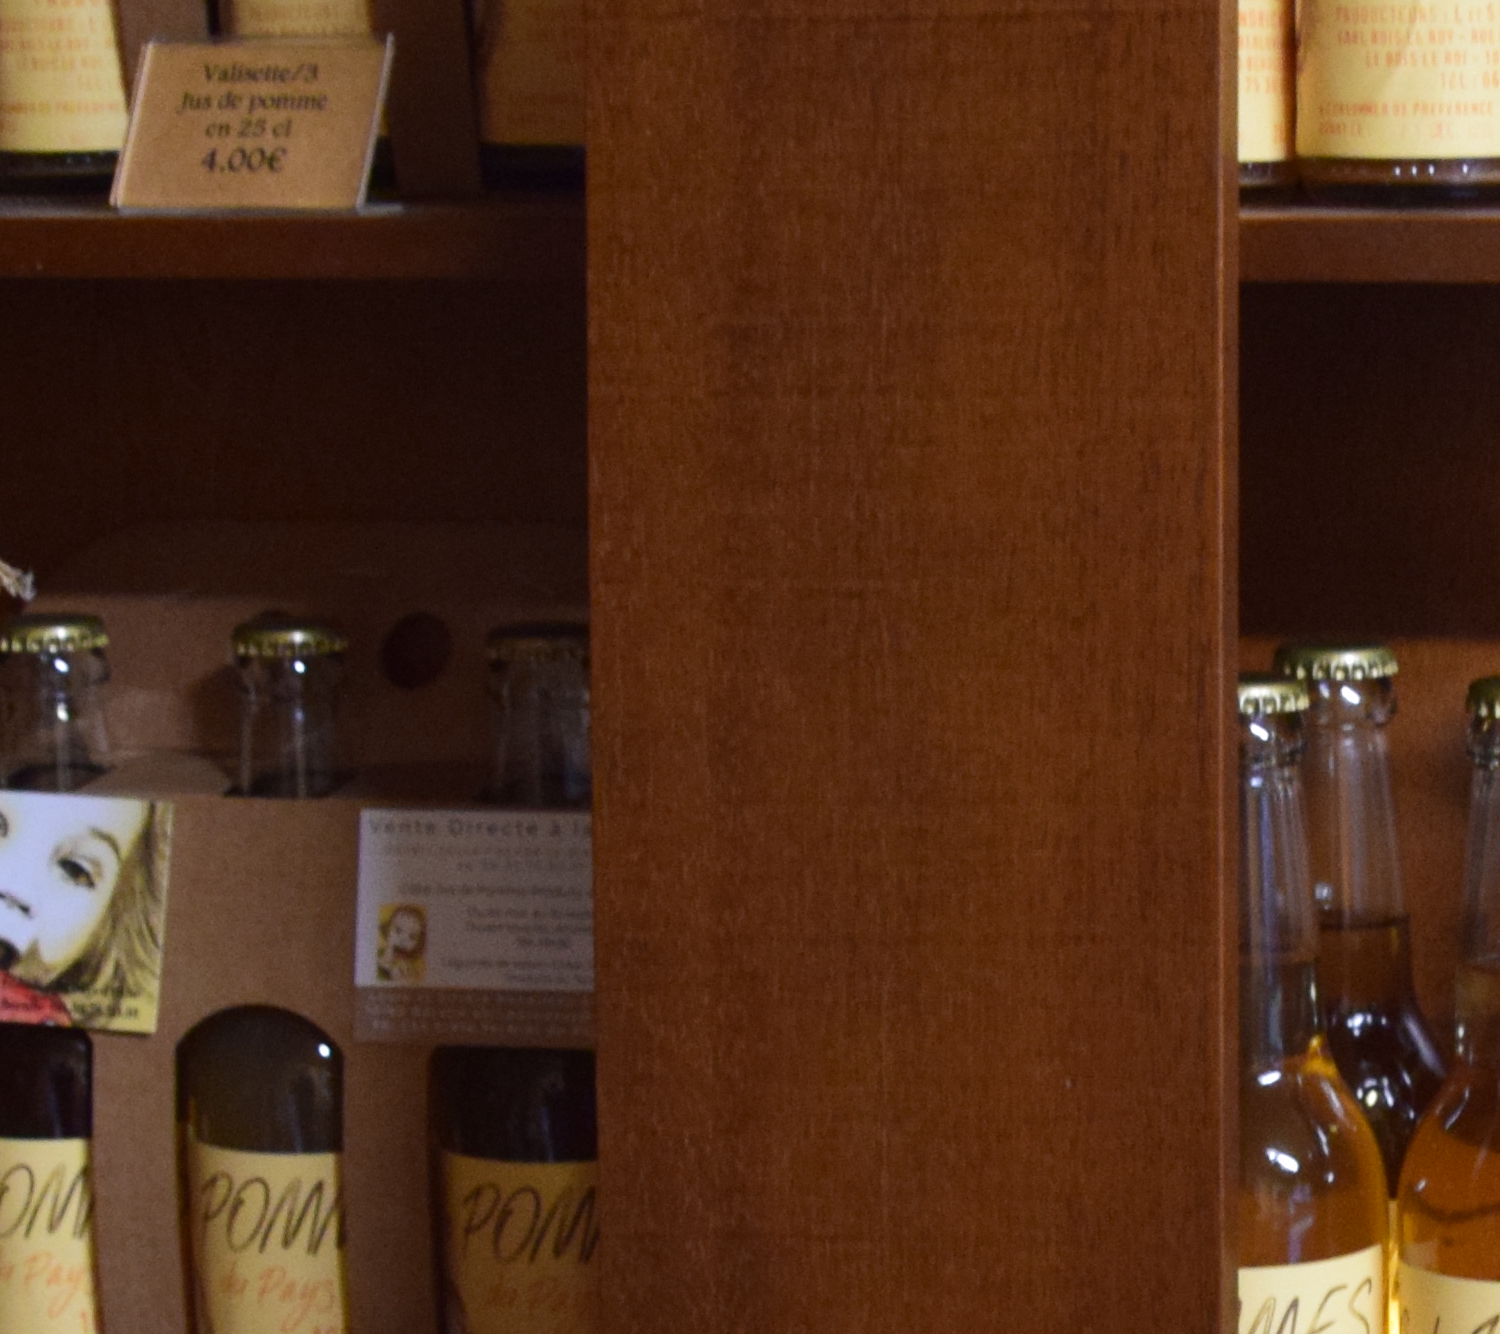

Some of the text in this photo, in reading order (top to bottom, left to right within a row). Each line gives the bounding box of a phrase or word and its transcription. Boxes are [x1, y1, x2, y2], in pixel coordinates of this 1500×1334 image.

[203, 63, 320, 83] Valisette/3
[177, 91, 328, 115] Jus de pomme
[204, 118, 292, 138] en 25 cl
[202, 147, 288, 173] 4.00€
[462, 1181, 600, 1264] POM
[258, 1265, 335, 1334] Pays
